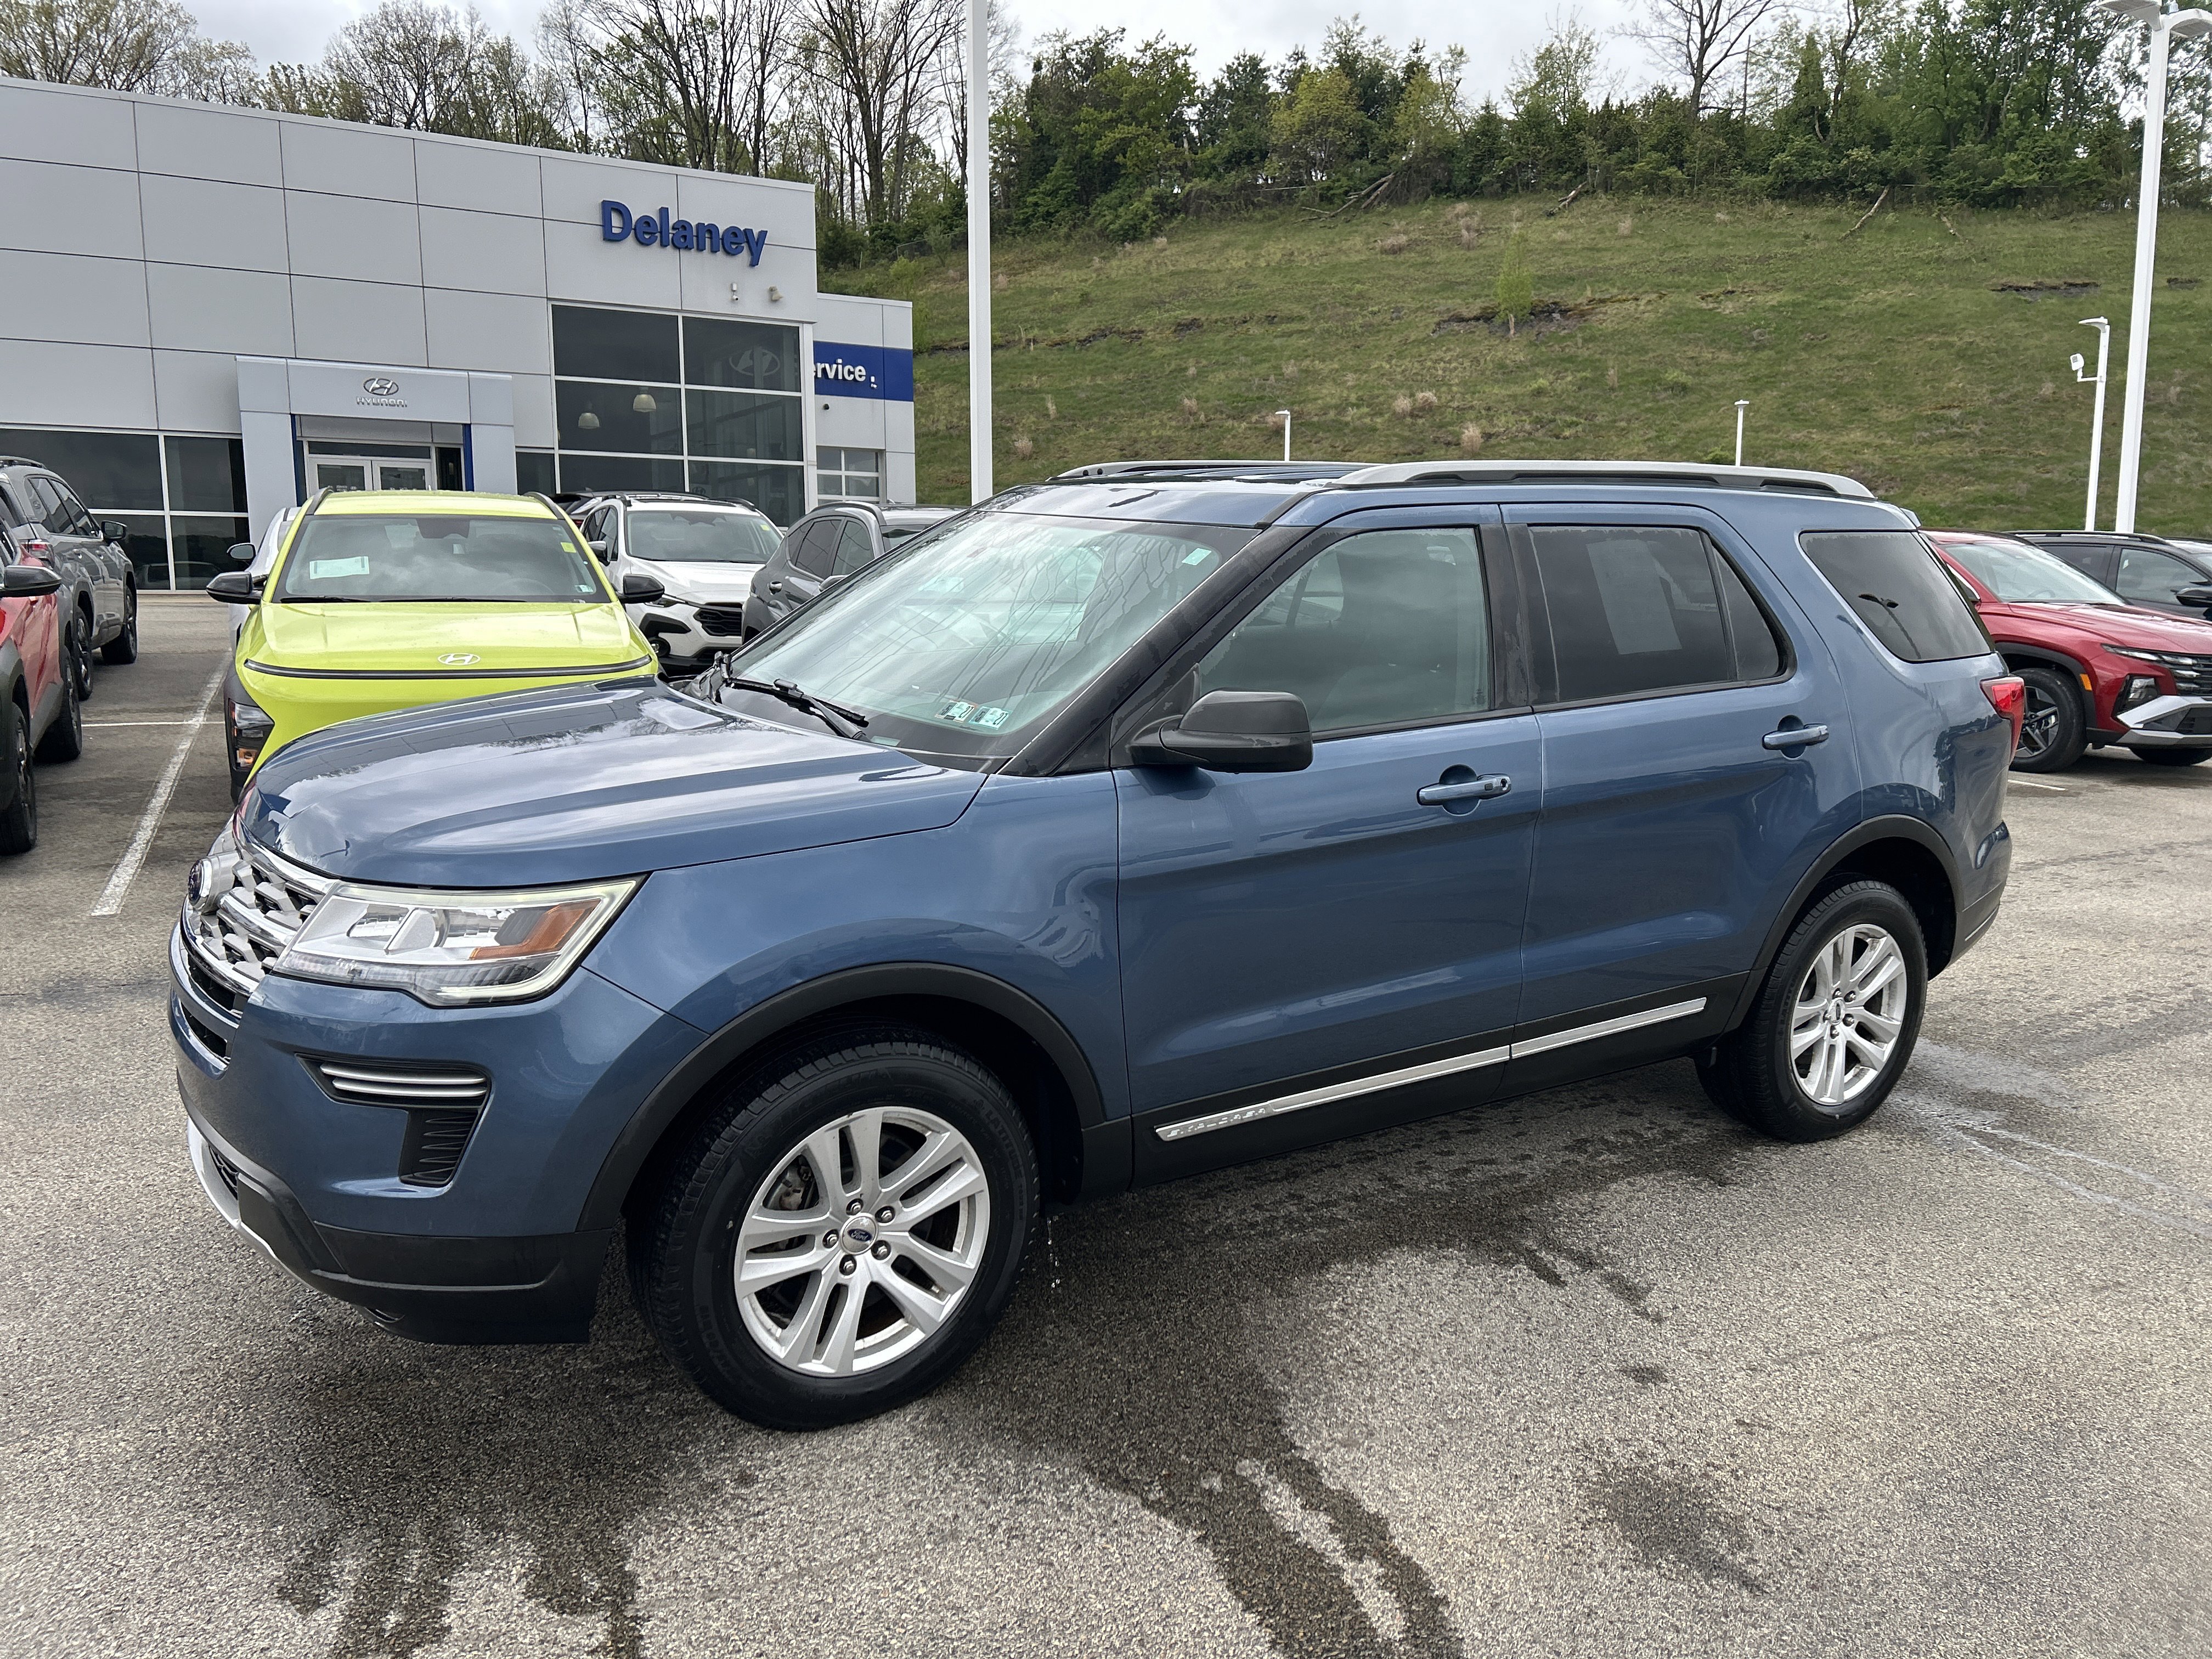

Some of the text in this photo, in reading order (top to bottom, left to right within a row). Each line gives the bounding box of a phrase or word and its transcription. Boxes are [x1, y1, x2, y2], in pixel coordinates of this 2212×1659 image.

[601, 200, 768, 267] Delaney
[813, 358, 866, 382] rvice
[356, 396, 408, 408] HYUNDAI
[985, 1109, 1024, 1179] LATITUDE
[850, 1230, 868, 1241] Ford
